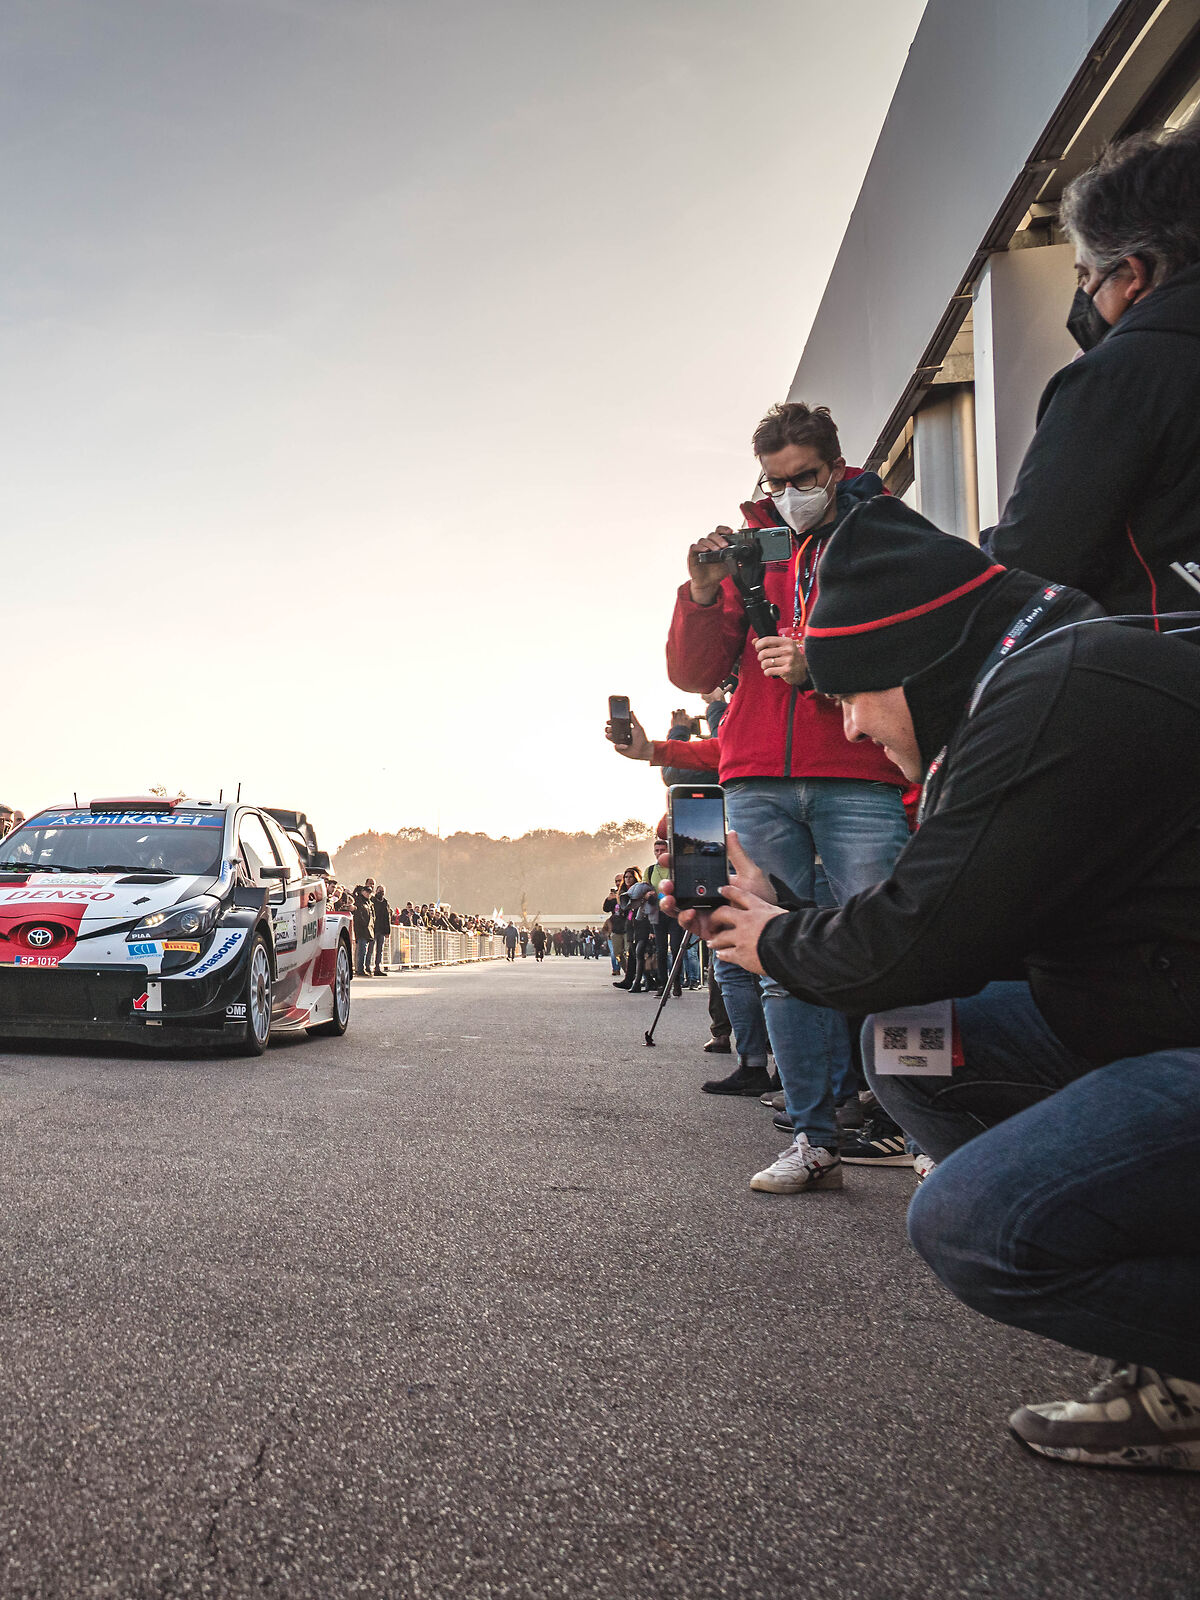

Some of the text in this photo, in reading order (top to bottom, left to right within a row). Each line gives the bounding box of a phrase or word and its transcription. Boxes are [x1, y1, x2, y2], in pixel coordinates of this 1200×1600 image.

[4, 890, 116, 902] DENSO
[185, 931, 243, 978] Panasonic
[21, 956, 57, 967] SP 1012
[226, 1005, 247, 1016] OMP
